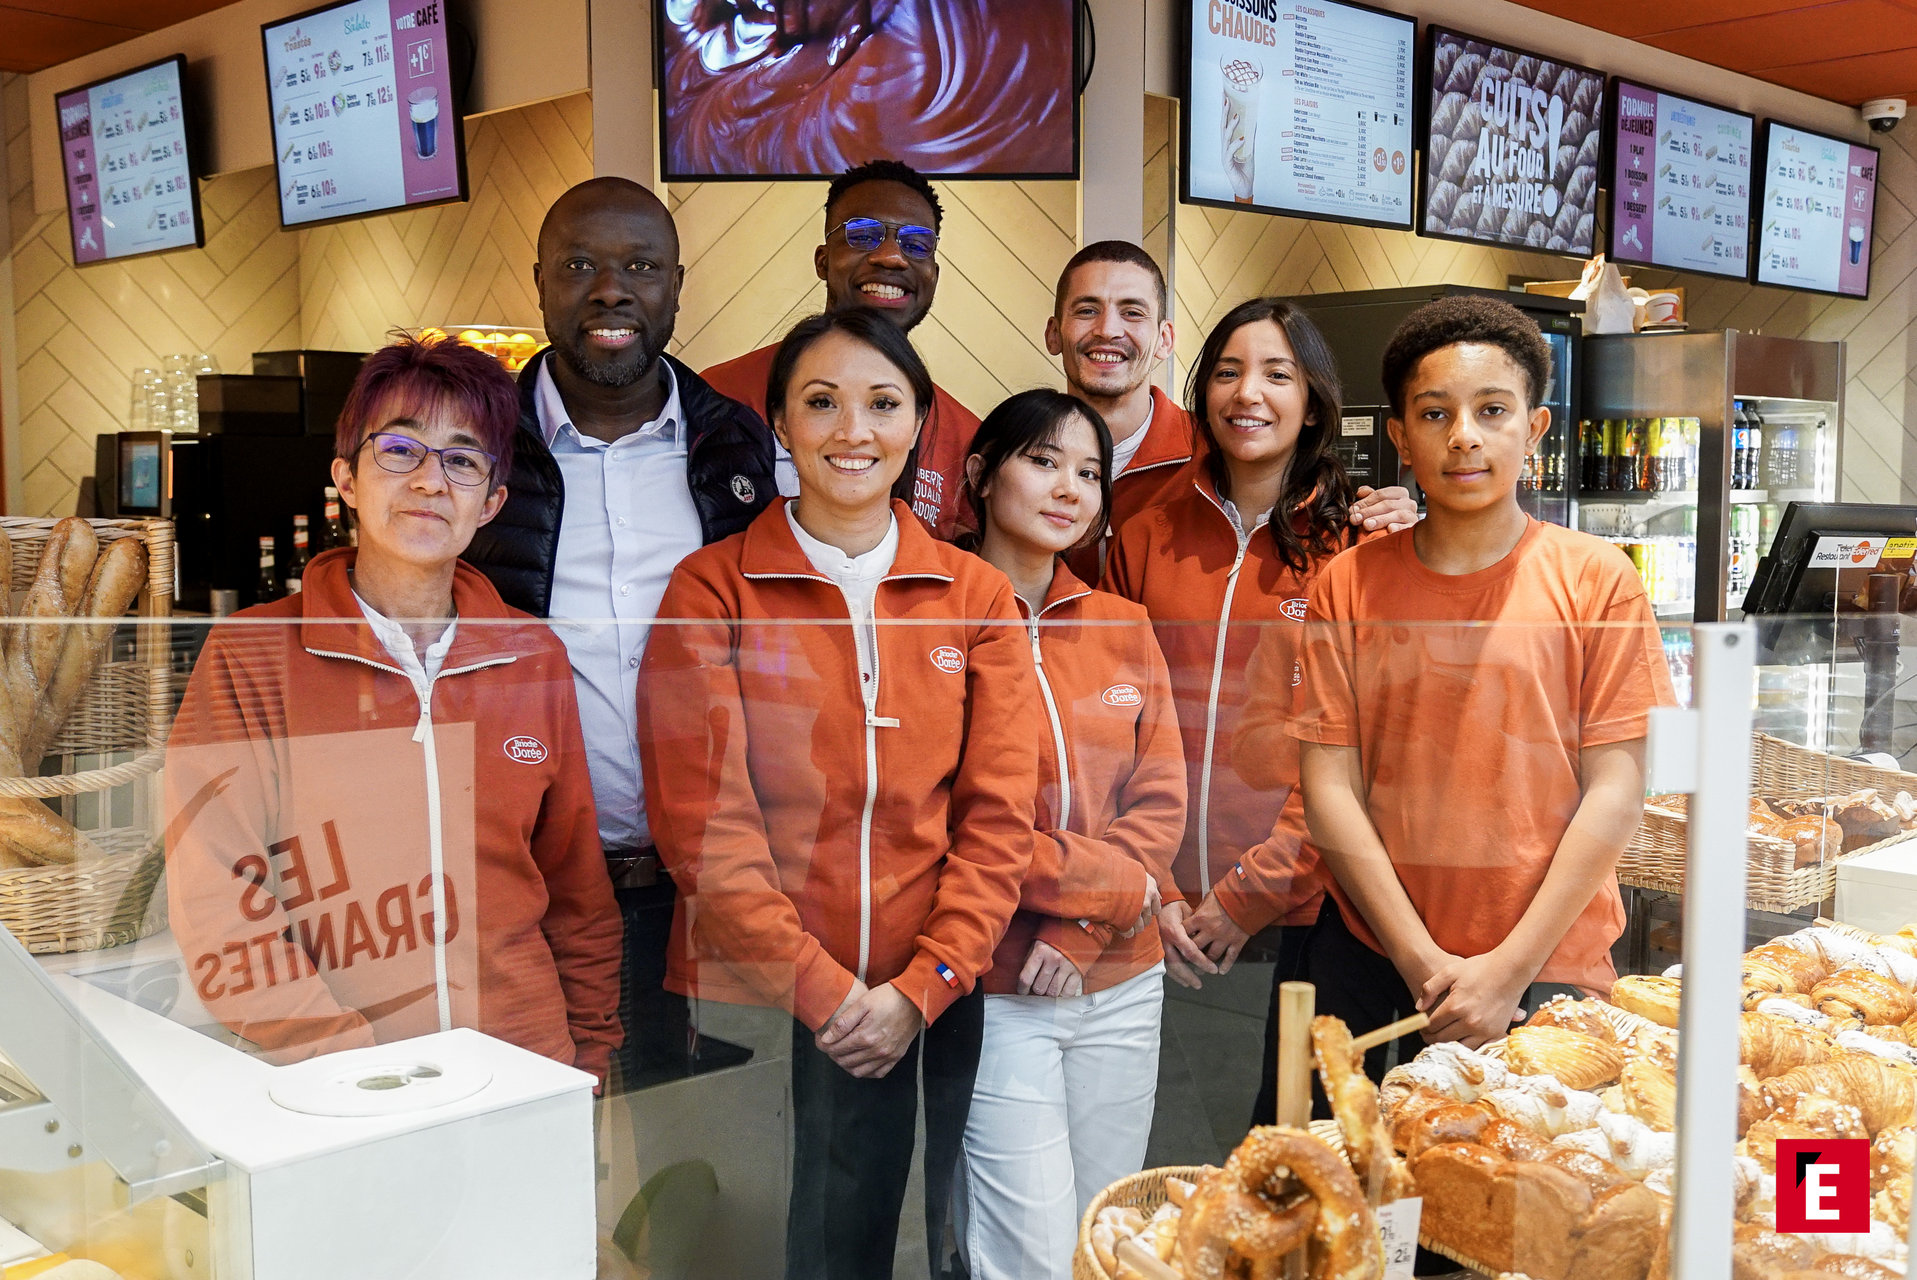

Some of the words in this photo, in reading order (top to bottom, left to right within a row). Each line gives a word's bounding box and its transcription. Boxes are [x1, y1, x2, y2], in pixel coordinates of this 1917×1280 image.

[416, 0, 439, 27] CAFÉ
[1208, 0, 1276, 47] CHAUDES
[1481, 78, 1548, 150] CUITS
[1621, 95, 1655, 118] FORMULE
[1474, 127, 1505, 178] AU
[1508, 141, 1544, 180] FOUR
[1473, 184, 1483, 204] ET
[1492, 182, 1543, 215] MESURE
[1816, 552, 1850, 561] Restauant
[1287, 605, 1306, 617] Dor
[937, 655, 961, 669] Dorée
[511, 746, 542, 759] Dorée
